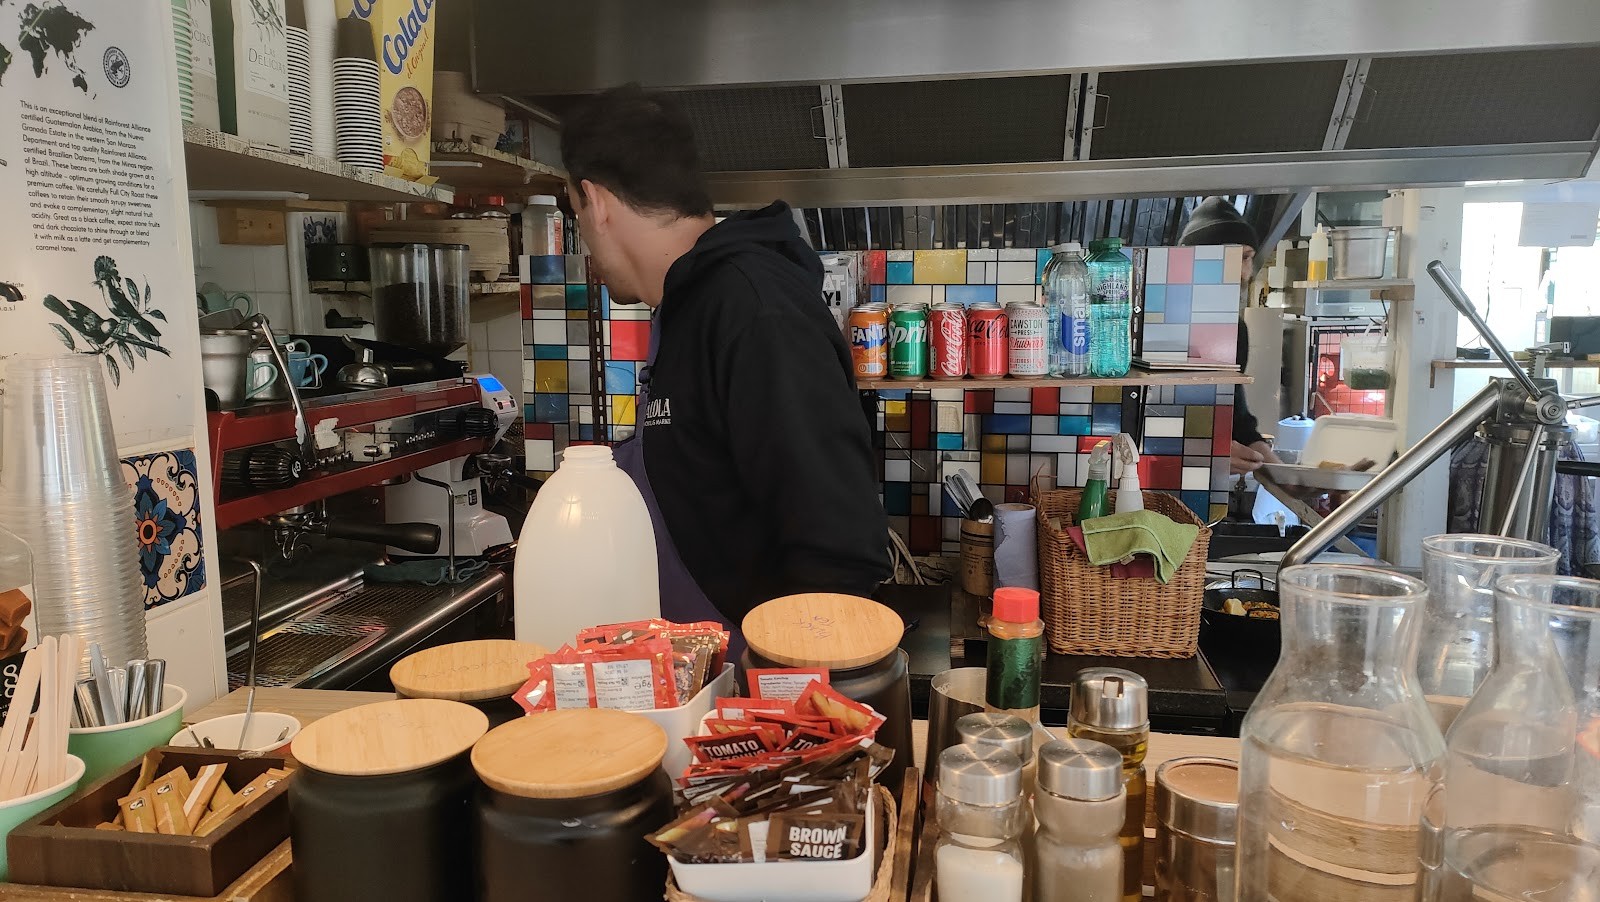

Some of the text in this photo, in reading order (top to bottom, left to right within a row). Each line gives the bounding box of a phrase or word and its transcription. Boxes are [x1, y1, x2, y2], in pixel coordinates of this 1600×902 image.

[20, 100, 32, 109] This
[49, 107, 82, 118] exceptional
[83, 112, 97, 122] blend
[104, 117, 130, 128] Rainforest
[131, 122, 151, 132] Alliance
[21, 114, 44, 122] certified
[45, 116, 81, 129] Guatemalan
[105, 128, 117, 136] from
[22, 123, 47, 134] Granada
[49, 128, 66, 137] Estate
[106, 138, 116, 146] San
[118, 140, 136, 149] Marcos
[22, 135, 57, 146] Department
[71, 143, 80, 152] top
[82, 145, 99, 155] quality
[100, 147, 126, 157] Rainforest
[128, 151, 147, 160] Alliance
[24, 147, 47, 155] certified
[48, 149, 73, 159] Brazilian
[98, 156, 110, 164] from
[122, 160, 137, 168] Minas
[32, 157, 50, 166] Brazil.
[52, 160, 69, 169] These
[70, 163, 87, 171] beans
[25, 168, 39, 177] high
[40, 170, 62, 179] altitude
[95, 178, 116, 187] growing
[118, 181, 142, 189] conditions
[86, 187, 108, 196] carefully
[120, 189, 130, 198] City
[67, 205, 109, 215] complementary,
[110, 208, 124, 216] slight
[109, 227, 128, 236] through
[112, 238, 150, 247] complementary
[1096, 282, 1128, 293] HIGHLAND
[1073, 294, 1086, 347] smart
[941, 310, 962, 376] Coca-Cola
[704, 740, 759, 757] TOMATO
[789, 826, 847, 844] BROWN
[790, 842, 843, 859] SAUCE
